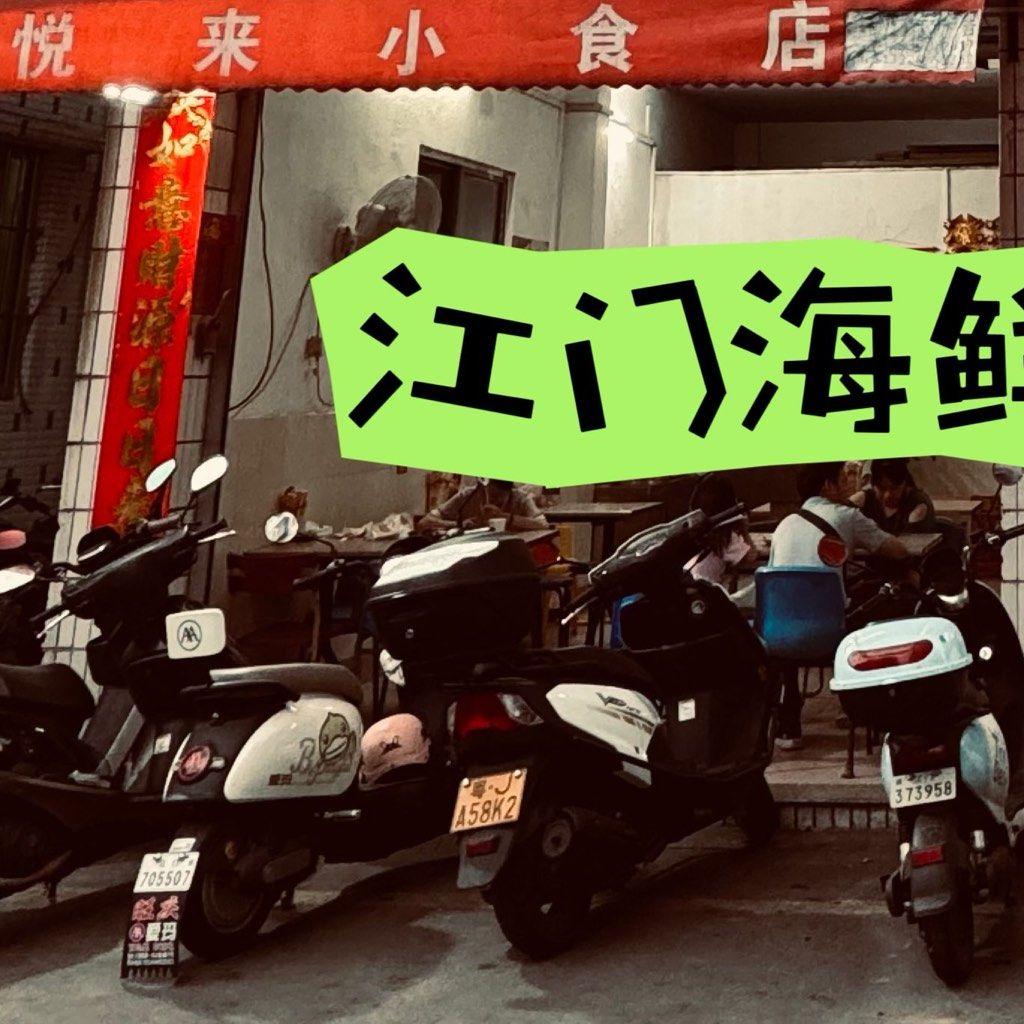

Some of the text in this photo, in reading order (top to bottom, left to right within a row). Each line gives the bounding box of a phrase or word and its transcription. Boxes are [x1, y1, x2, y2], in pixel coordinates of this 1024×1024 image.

[12, 1, 830, 80] 悦来小食店
[894, 780, 953, 804] 373958
[455, 795, 518, 829] A58K2
[140, 870, 191, 888] 705507
